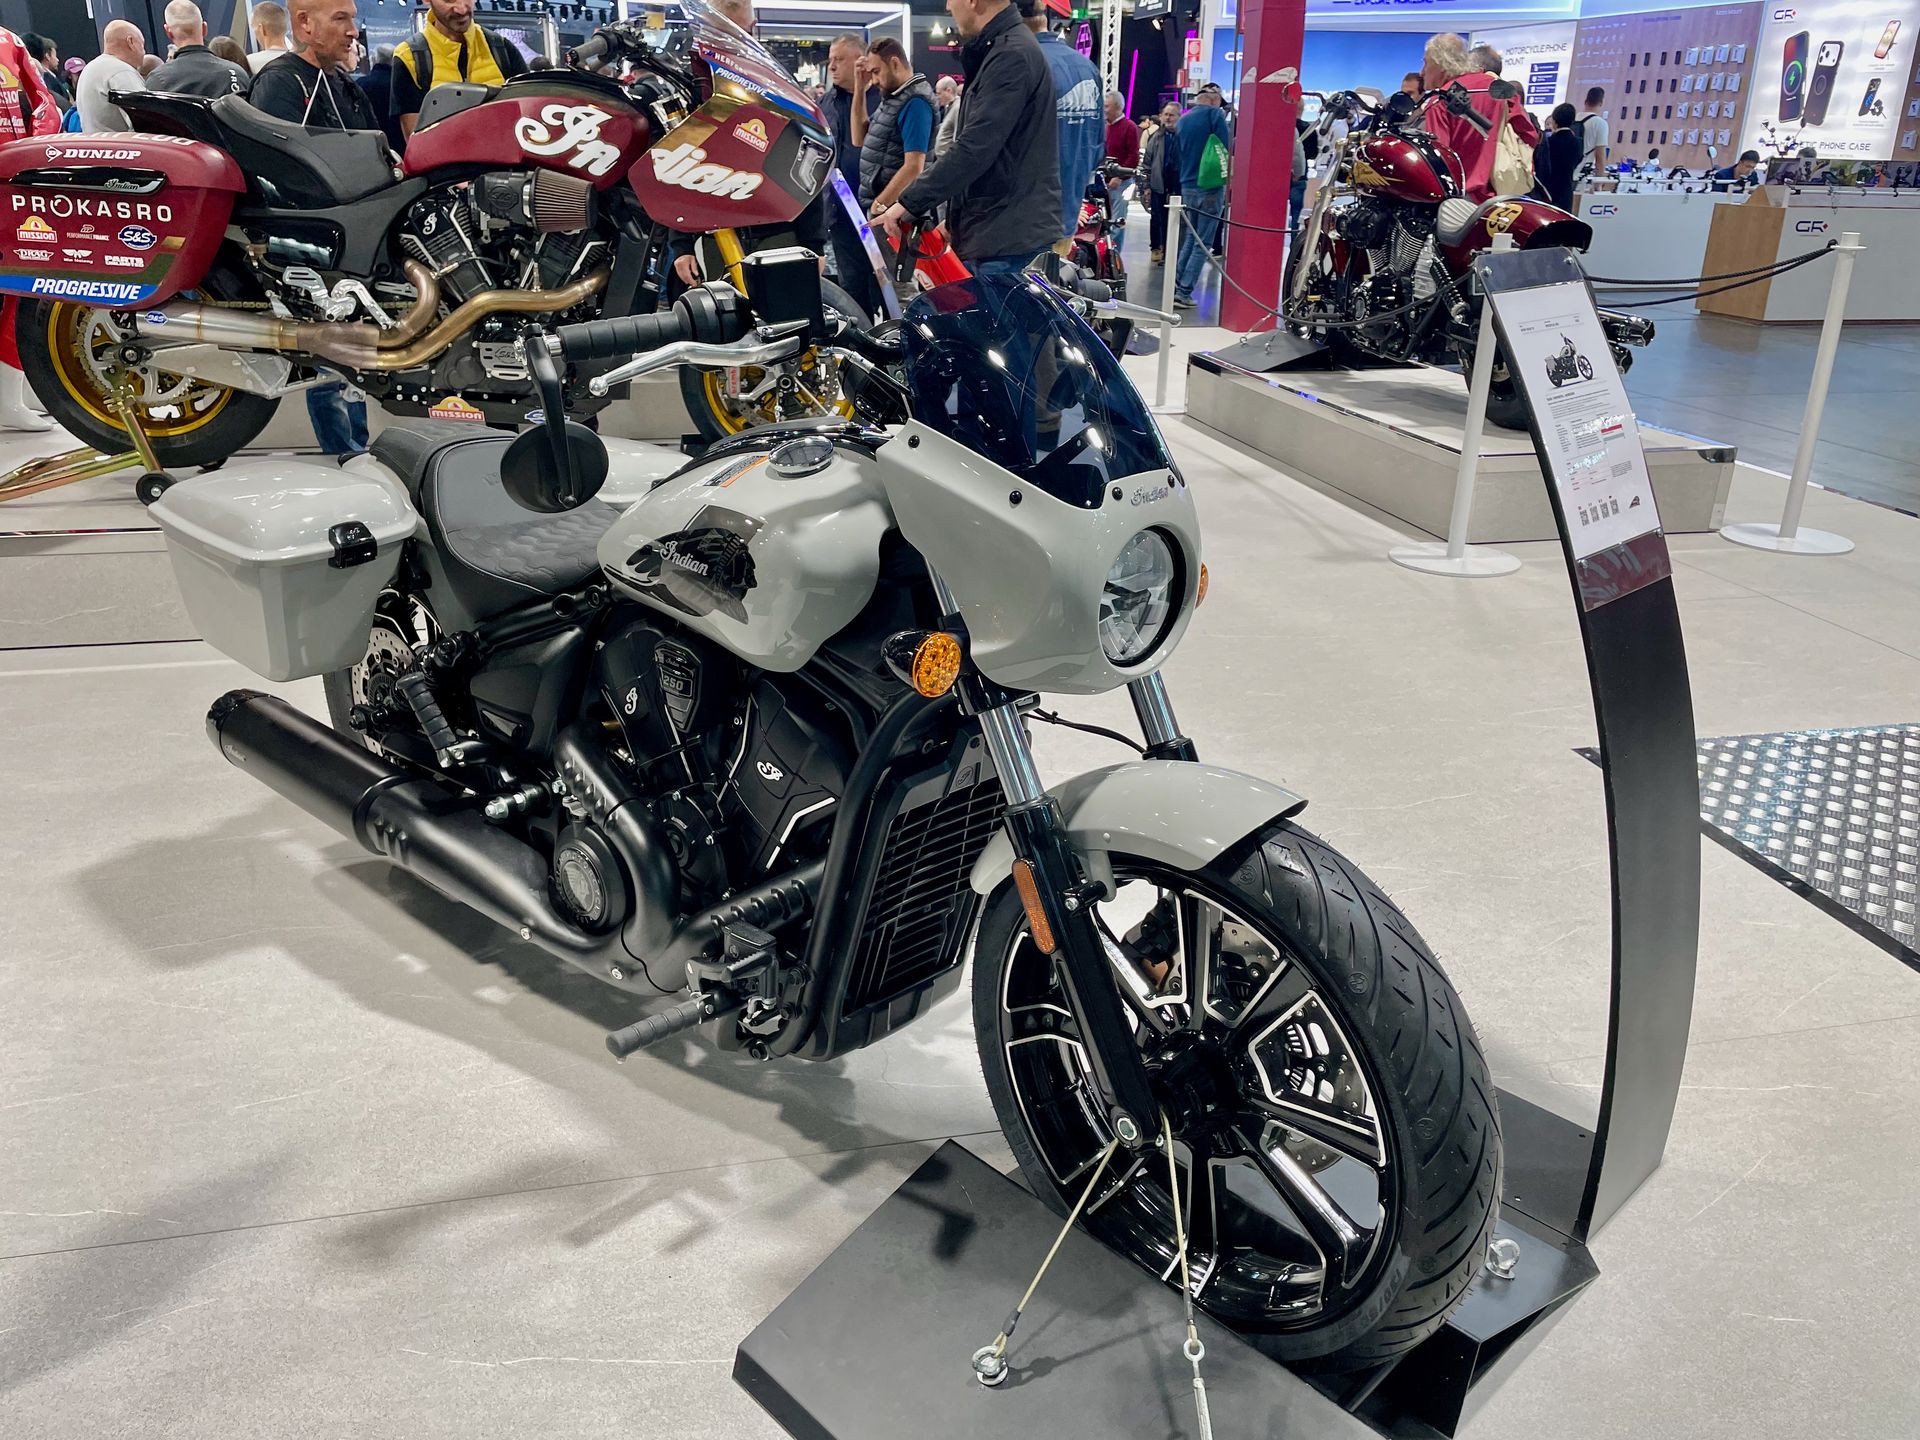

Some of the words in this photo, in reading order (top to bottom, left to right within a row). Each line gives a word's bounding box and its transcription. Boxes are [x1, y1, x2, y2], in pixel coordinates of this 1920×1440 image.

[715, 67, 768, 97] PROGRESSIVE
[64, 148, 141, 160] DUNLOP
[1819, 141, 1846, 150] PHONE
[1848, 142, 1871, 151] CASE
[650, 142, 764, 200] dian
[103, 178, 140, 191] Indian
[11, 193, 173, 223] PROKASRO
[122, 230, 151, 243] S&S
[32, 278, 141, 300] PROGRESSIVE
[1131, 486, 1169, 506] Indian
[659, 540, 709, 577] Indian
